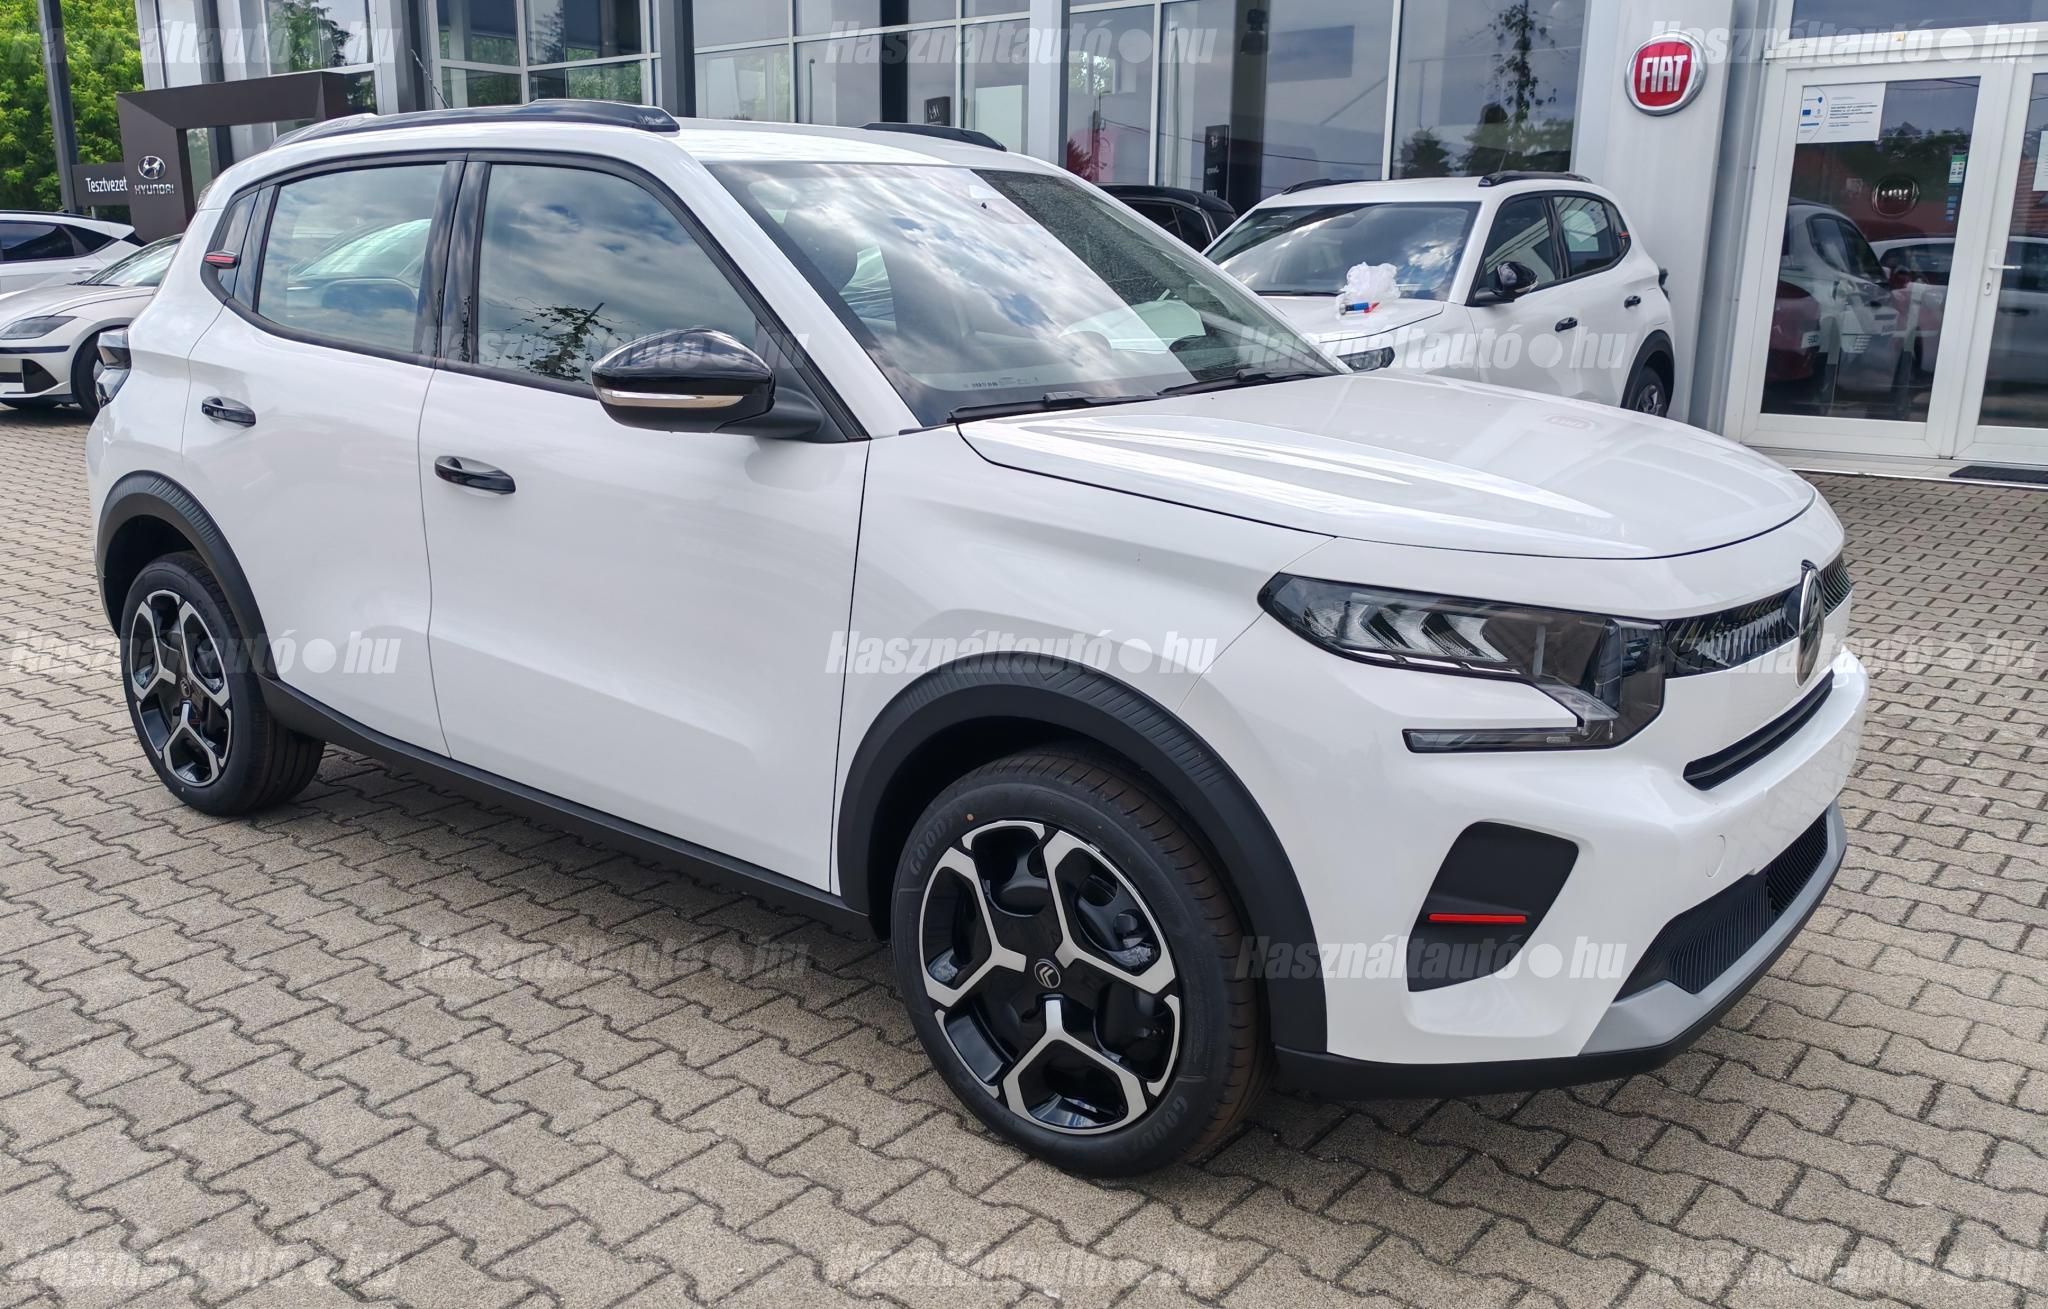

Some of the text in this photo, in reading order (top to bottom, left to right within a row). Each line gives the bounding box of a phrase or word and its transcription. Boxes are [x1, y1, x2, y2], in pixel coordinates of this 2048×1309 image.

[1640, 55, 1688, 93] FIAT
[85, 176, 128, 193] Tesztvezet
[134, 184, 175, 195] HYUNDAI
